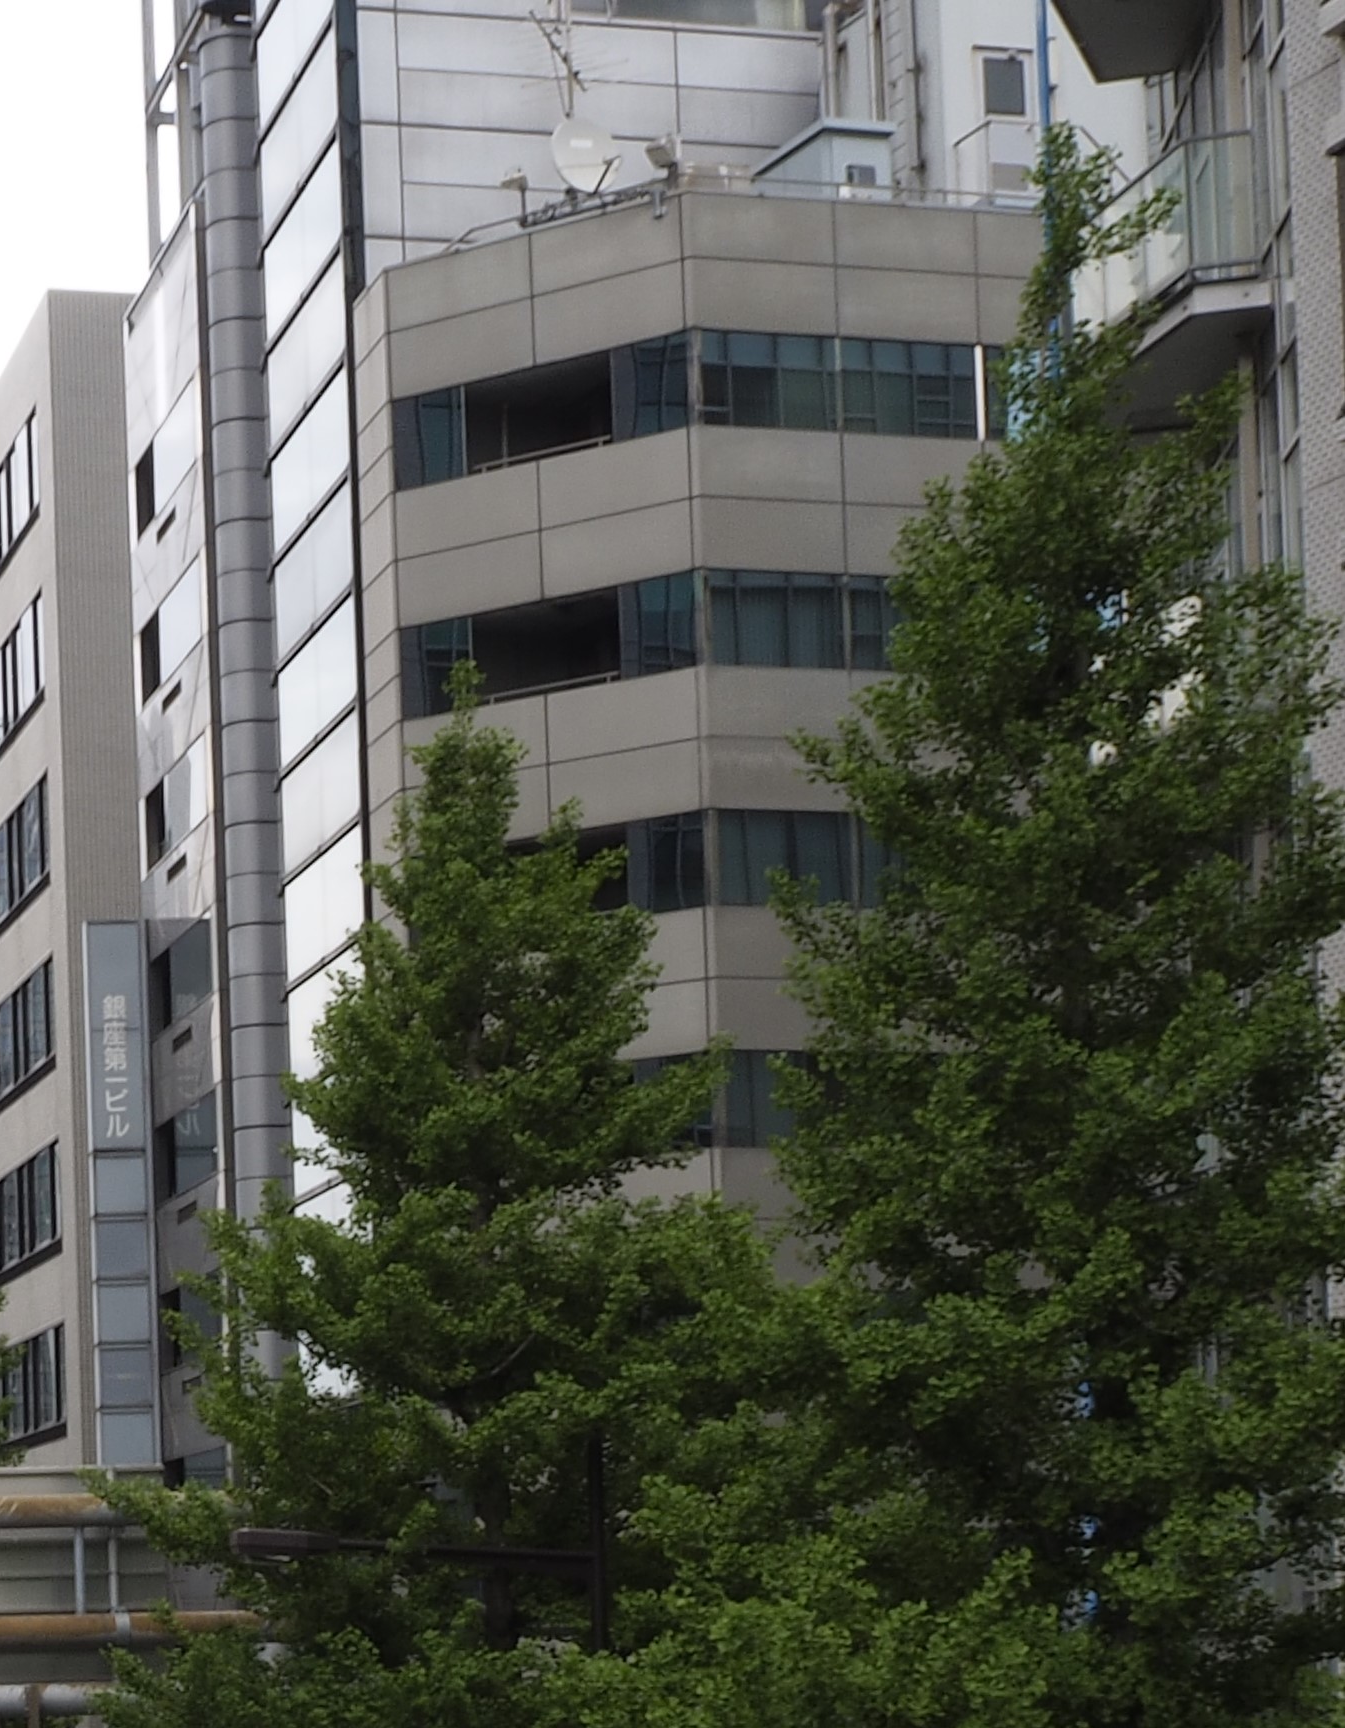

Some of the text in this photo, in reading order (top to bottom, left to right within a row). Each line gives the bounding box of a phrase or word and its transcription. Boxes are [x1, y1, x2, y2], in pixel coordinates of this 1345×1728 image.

[103, 995, 129, 1138] 銀座第一ビル
